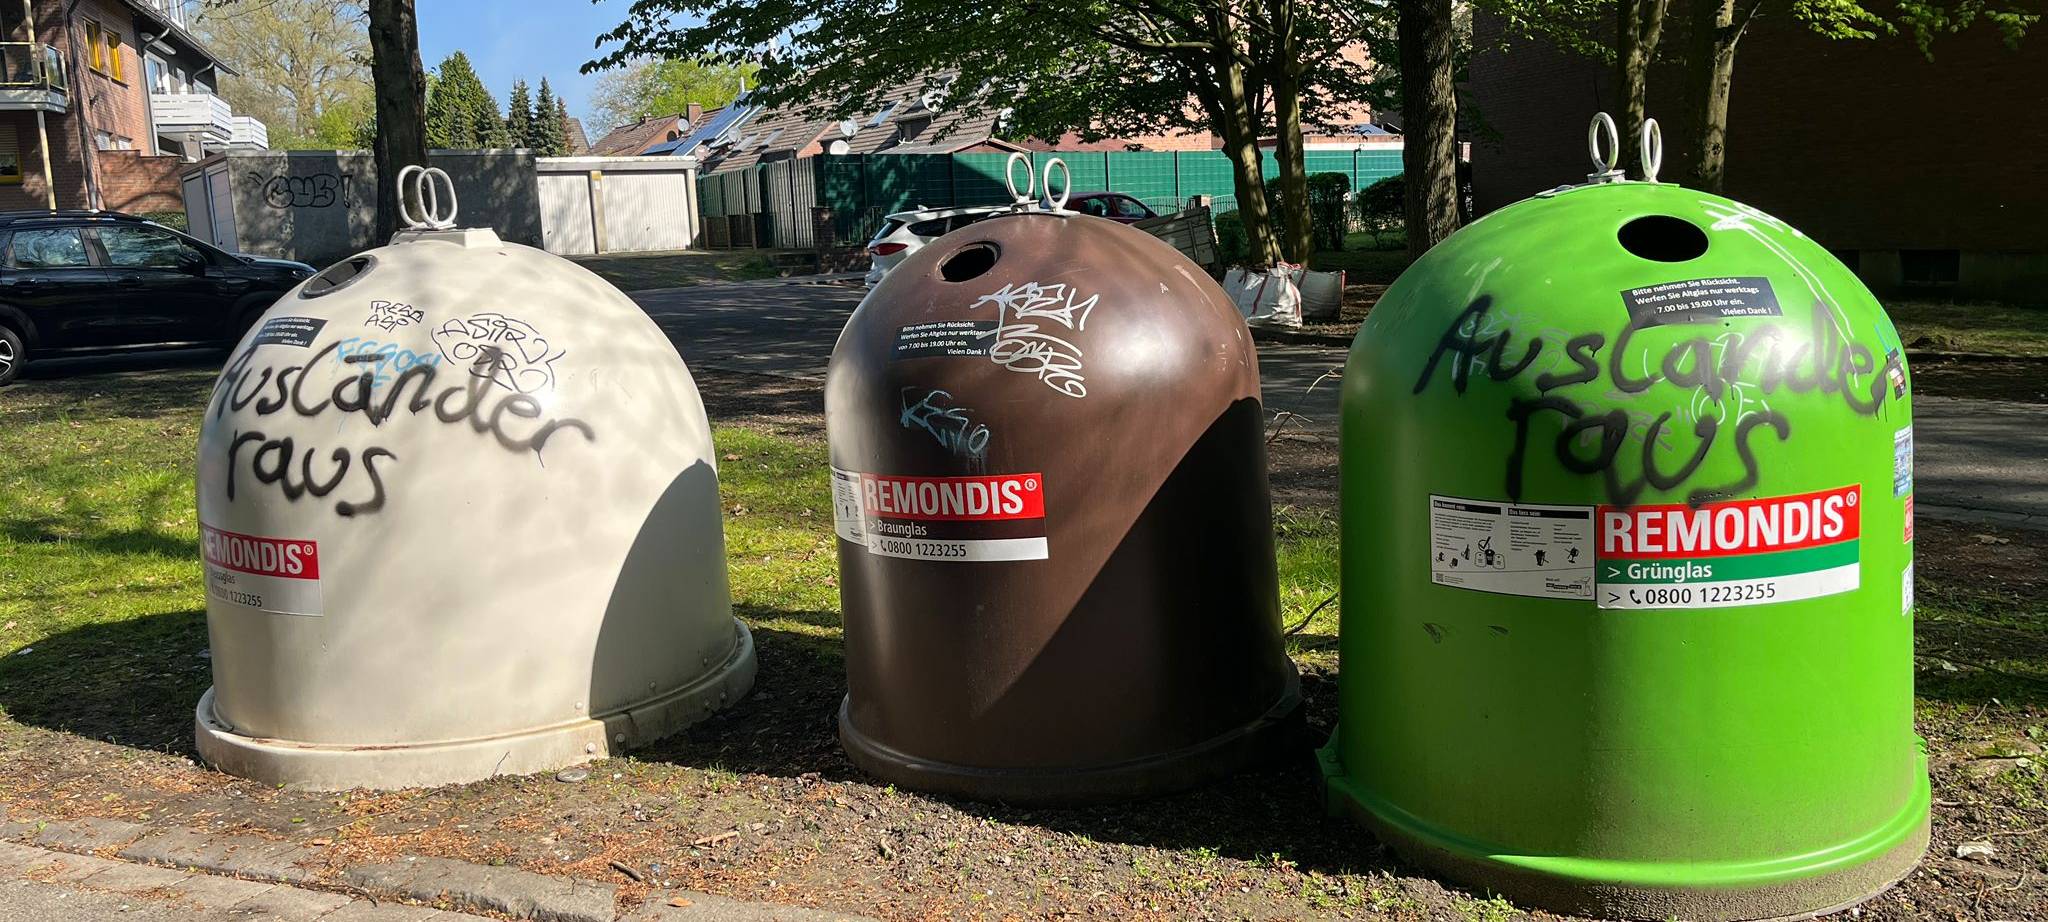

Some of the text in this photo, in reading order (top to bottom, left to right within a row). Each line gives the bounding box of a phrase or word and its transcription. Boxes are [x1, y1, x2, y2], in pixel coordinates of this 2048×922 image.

[1632, 288, 1652, 296] Bitte
[1654, 283, 1686, 293] nehmen
[1701, 278, 1740, 286] Rücksicht.
[1635, 295, 1667, 305] Werfen
[1668, 292, 1680, 300] Sie
[1682, 289, 1708, 298] Altglas
[1724, 286, 1759, 295] werktags
[1657, 305, 1675, 313] 7.00
[1690, 300, 1712, 309] 19.00
[1721, 308, 1746, 316] Vielen
[1747, 307, 1767, 315] Dank
[915, 323, 936, 331] nehmen
[1506, 397, 1789, 508] raus
[226, 429, 397, 517] raus
[878, 520, 927, 539] Braunglas
[887, 542, 967, 557] 0800 1223255
[1627, 561, 1712, 583] Grünglas
[230, 591, 262, 607] 1223255
[1645, 583, 1775, 605] 0800 1223255
